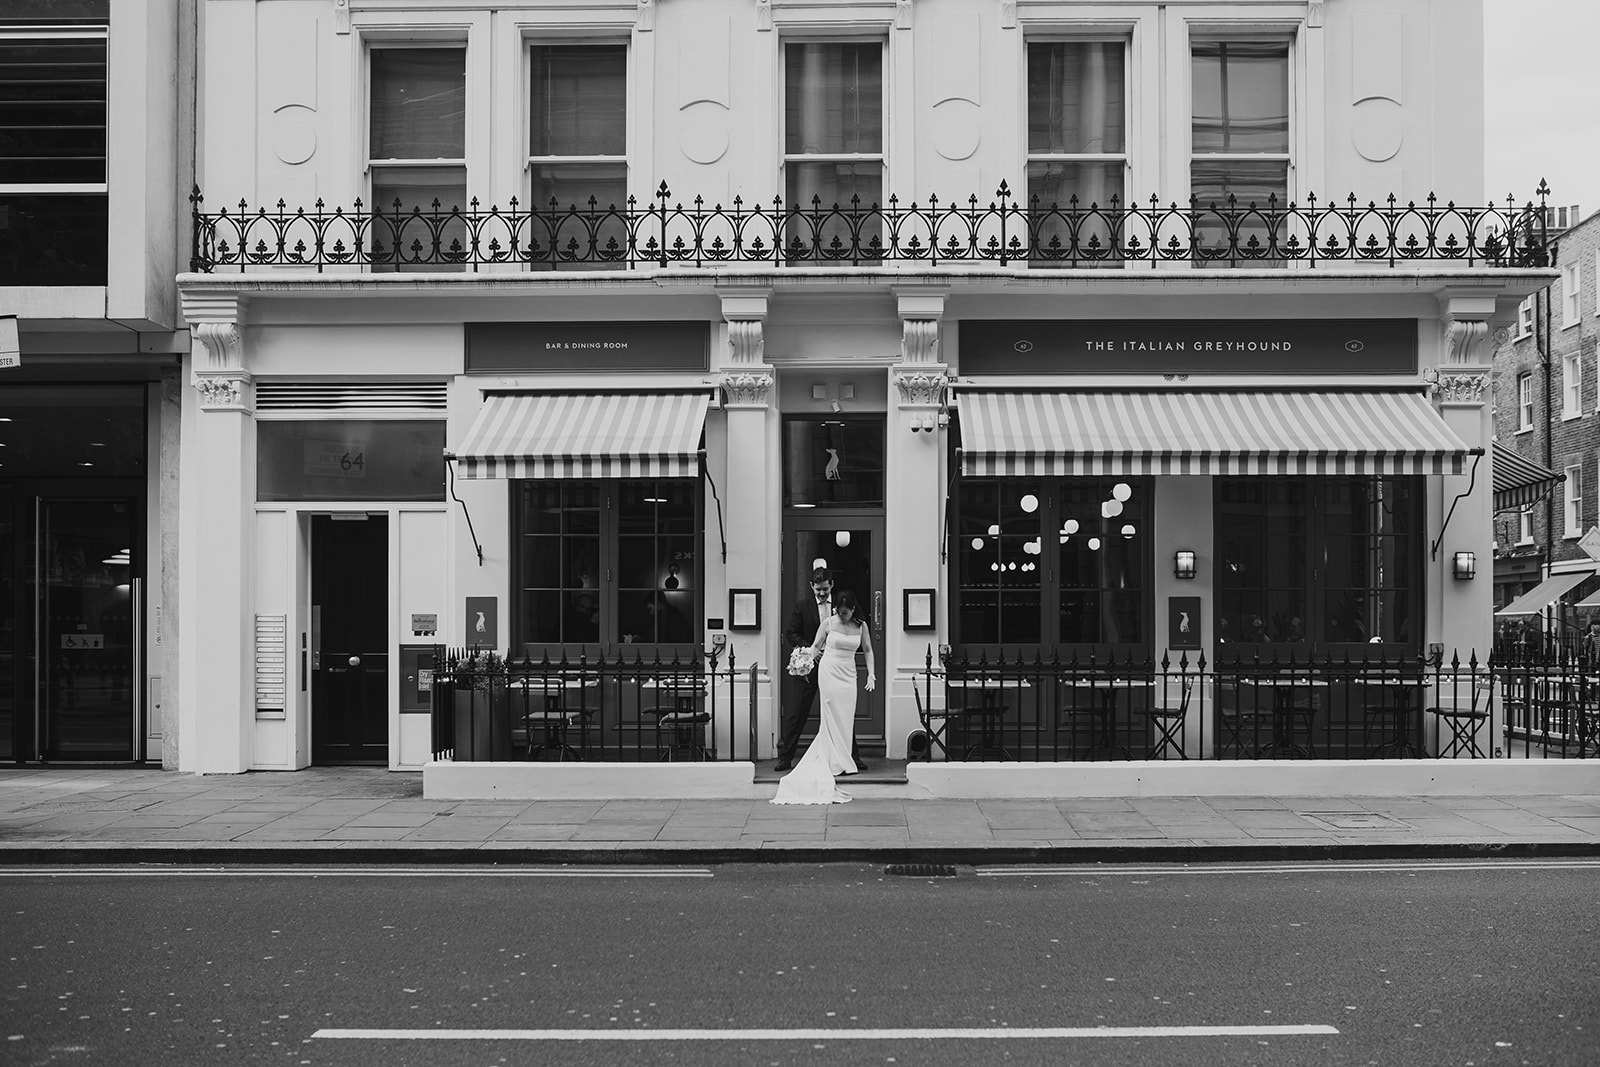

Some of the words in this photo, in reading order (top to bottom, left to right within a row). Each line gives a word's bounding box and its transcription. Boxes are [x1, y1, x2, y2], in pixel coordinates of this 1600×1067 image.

[545, 342, 561, 350] BAR
[564, 342, 570, 350] &
[1085, 341, 1113, 351] THE
[1123, 341, 1184, 351] ITALIAN
[1194, 341, 1292, 352] GREYHOUND
[341, 452, 364, 470] 64
